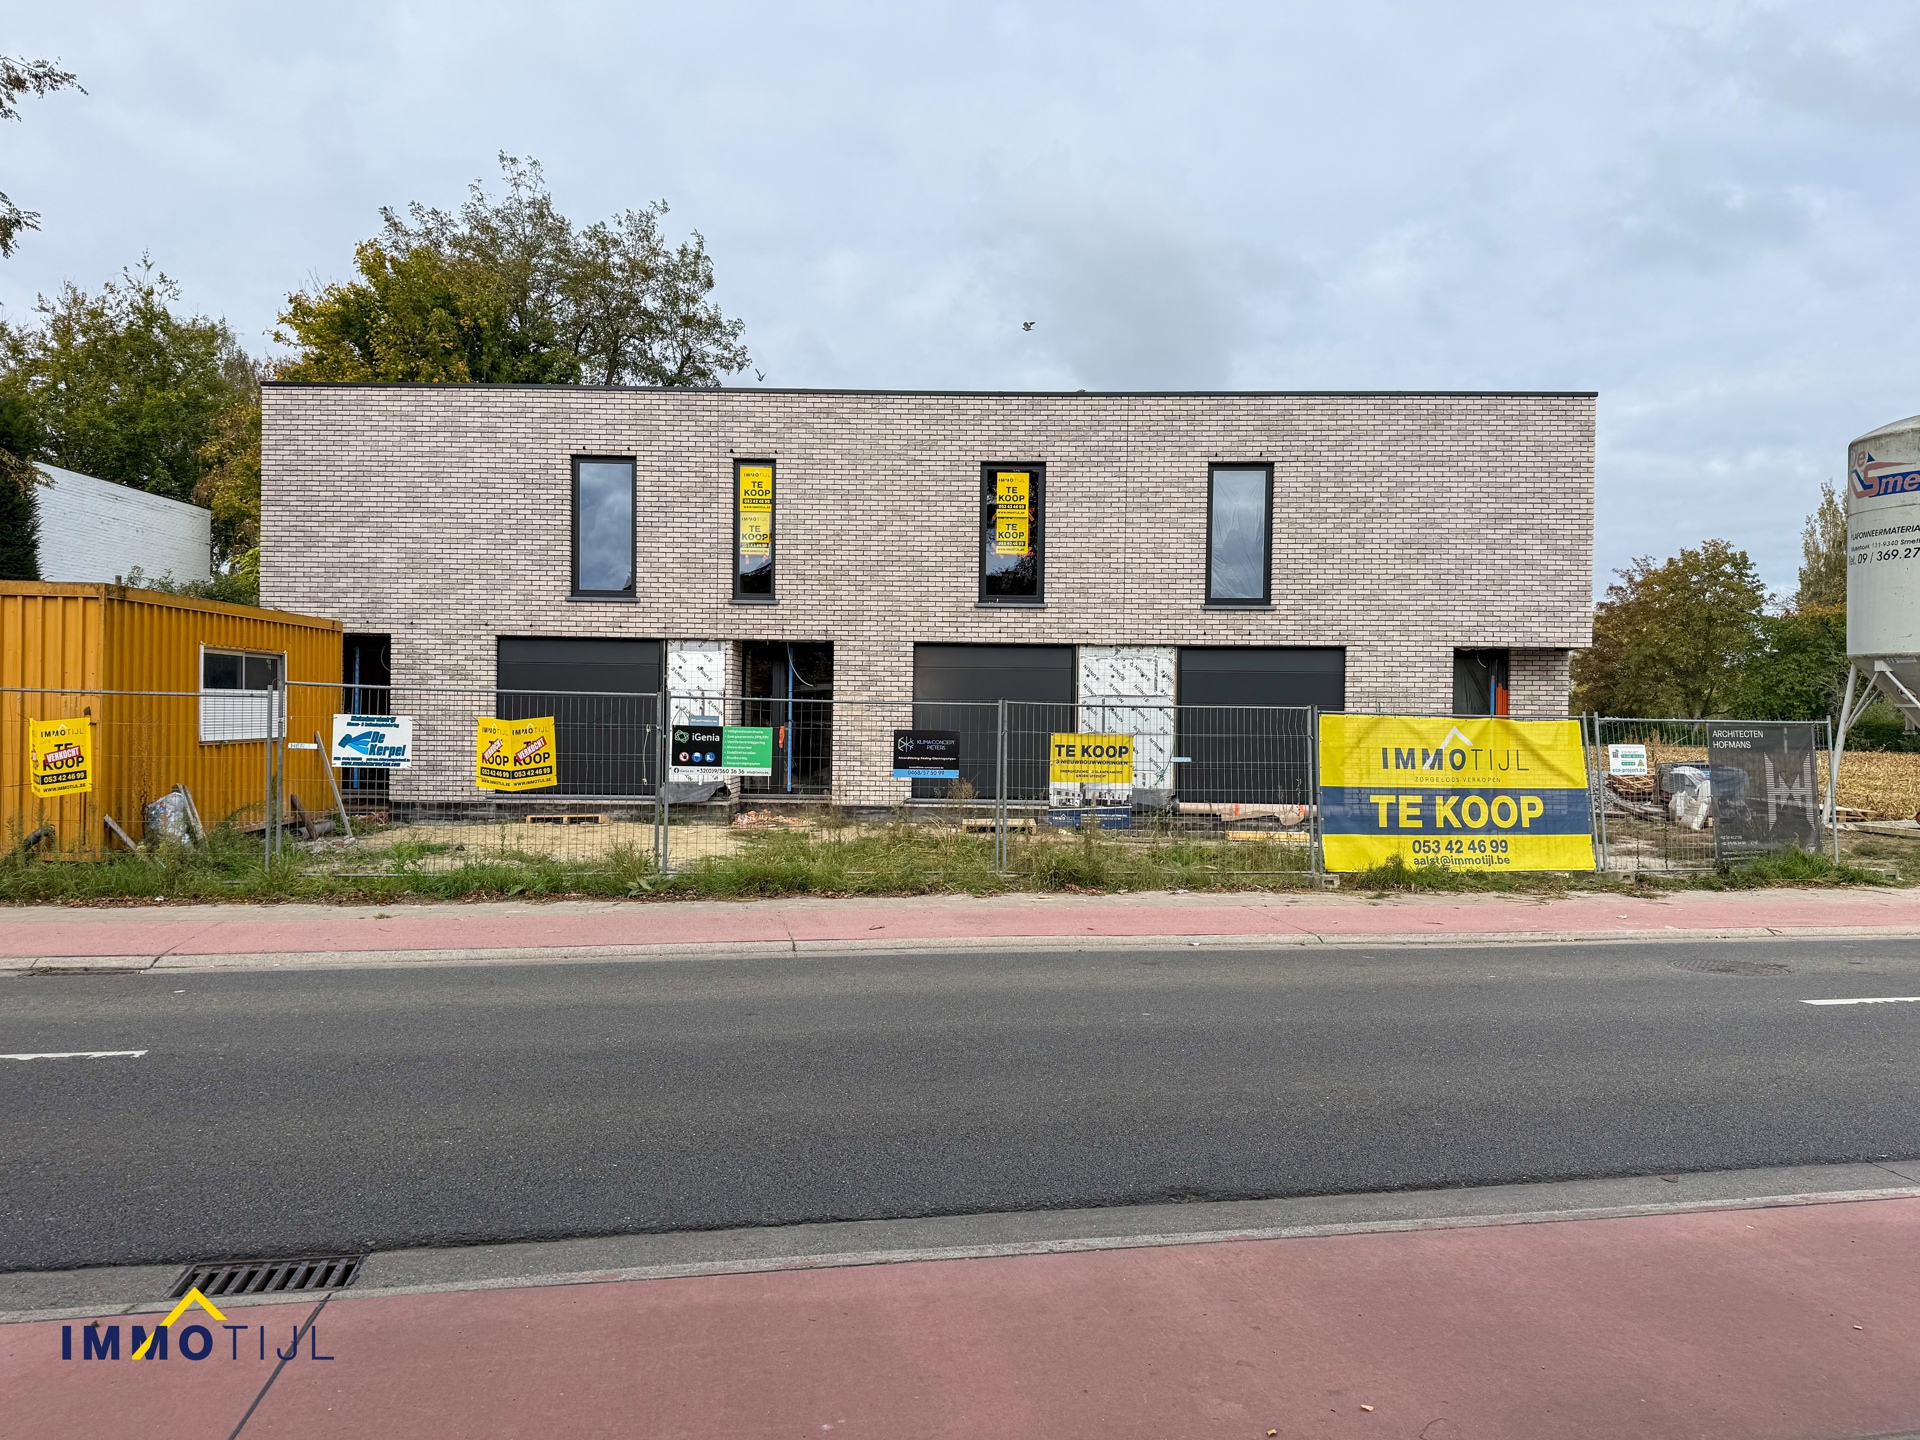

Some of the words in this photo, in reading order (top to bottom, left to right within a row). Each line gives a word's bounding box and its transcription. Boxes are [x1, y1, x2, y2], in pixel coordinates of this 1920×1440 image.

[1851, 450, 1867, 470] De
[1858, 553, 1868, 564] 09
[1876, 547, 1920, 561] 369.27
[41, 728, 83, 738] IMMOTIJL
[371, 731, 386, 743] De
[512, 727, 549, 735] IMMOTIJL
[692, 733, 720, 742] iGenia
[1712, 730, 1764, 738] ARCHITECTEN
[369, 744, 406, 758] Kerpel
[517, 738, 545, 761] VERKOCHT
[1055, 744, 1076, 757] TE
[1081, 745, 1129, 758] KOOP
[1712, 741, 1751, 749] HOFMANS
[46, 747, 79, 762] VERKOCHT
[1382, 747, 1530, 771] IMMOTIJL
[43, 756, 84, 771] KOOP
[1370, 795, 1423, 828] TE
[1435, 795, 1543, 829] KOOP
[1412, 840, 1441, 854] 053
[1444, 840, 1464, 854] 42
[1468, 840, 1487, 854] 46
[1490, 840, 1509, 854] 99
[1413, 856, 1510, 867] aalst@immotijl.be
